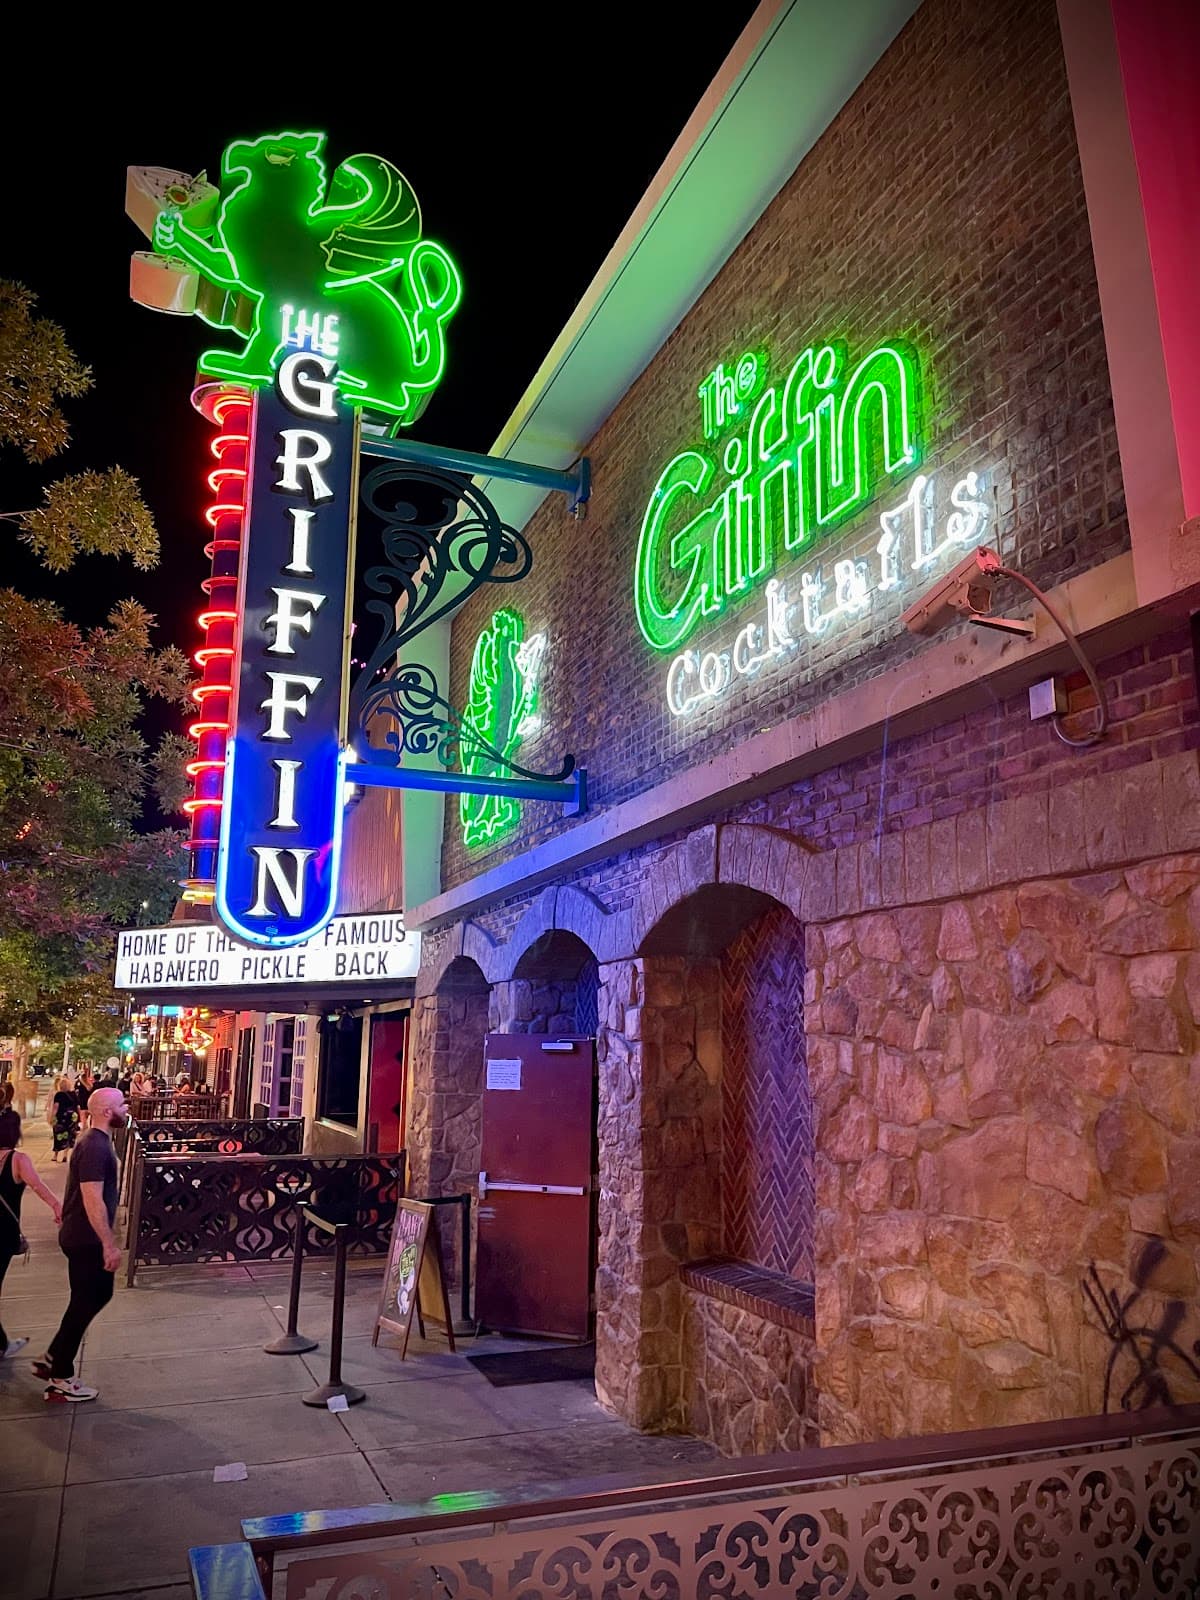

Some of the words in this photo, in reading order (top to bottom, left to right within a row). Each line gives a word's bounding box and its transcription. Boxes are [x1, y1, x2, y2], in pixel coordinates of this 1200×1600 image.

[280, 303, 341, 357] THE
[697, 350, 760, 441] The
[665, 470, 989, 717] Cocktails
[243, 351, 340, 918] GRIFFIN
[121, 932, 168, 958] HOME
[175, 931, 198, 955] OF
[324, 918, 407, 948] FAMOUS
[128, 958, 220, 985] HABANERO
[240, 954, 307, 981] PICKLE
[334, 950, 390, 977] BACK
